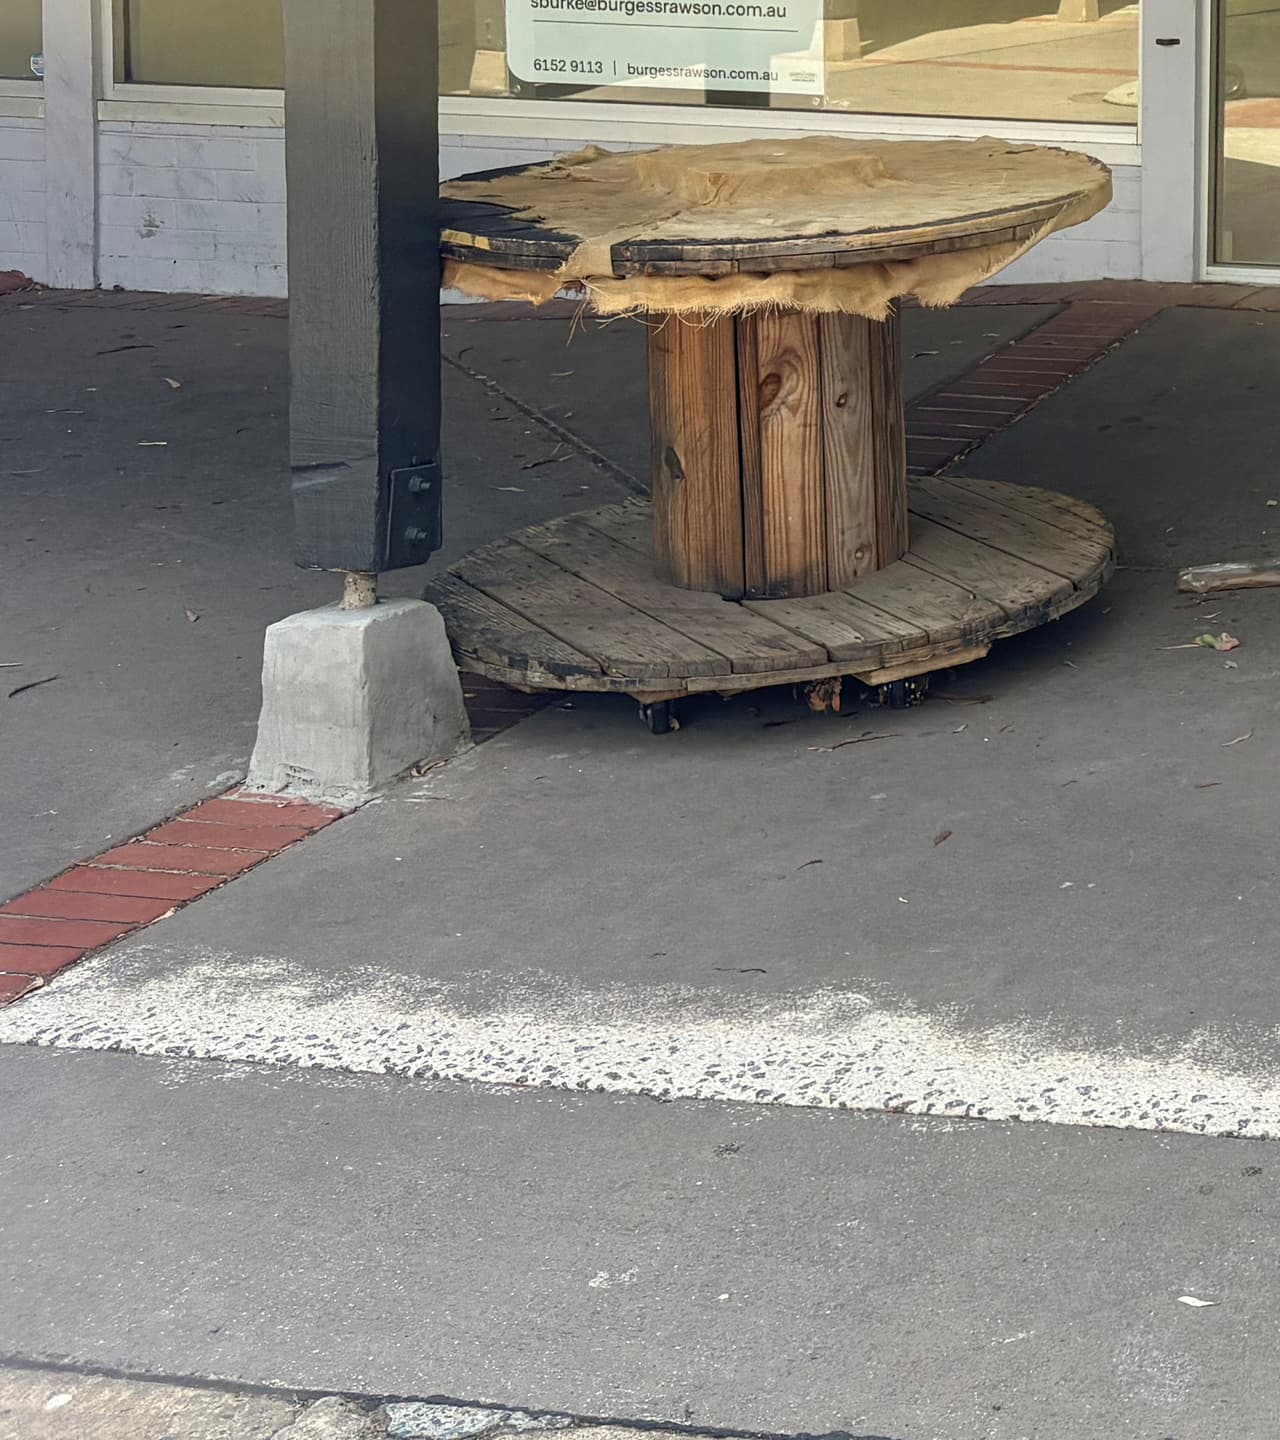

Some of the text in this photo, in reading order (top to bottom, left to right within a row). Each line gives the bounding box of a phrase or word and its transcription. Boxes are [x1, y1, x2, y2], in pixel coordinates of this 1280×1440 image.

[533, 58, 567, 73] 6152
[570, 60, 604, 75] 9113
[627, 61, 779, 82] burgessrawson.com.au
